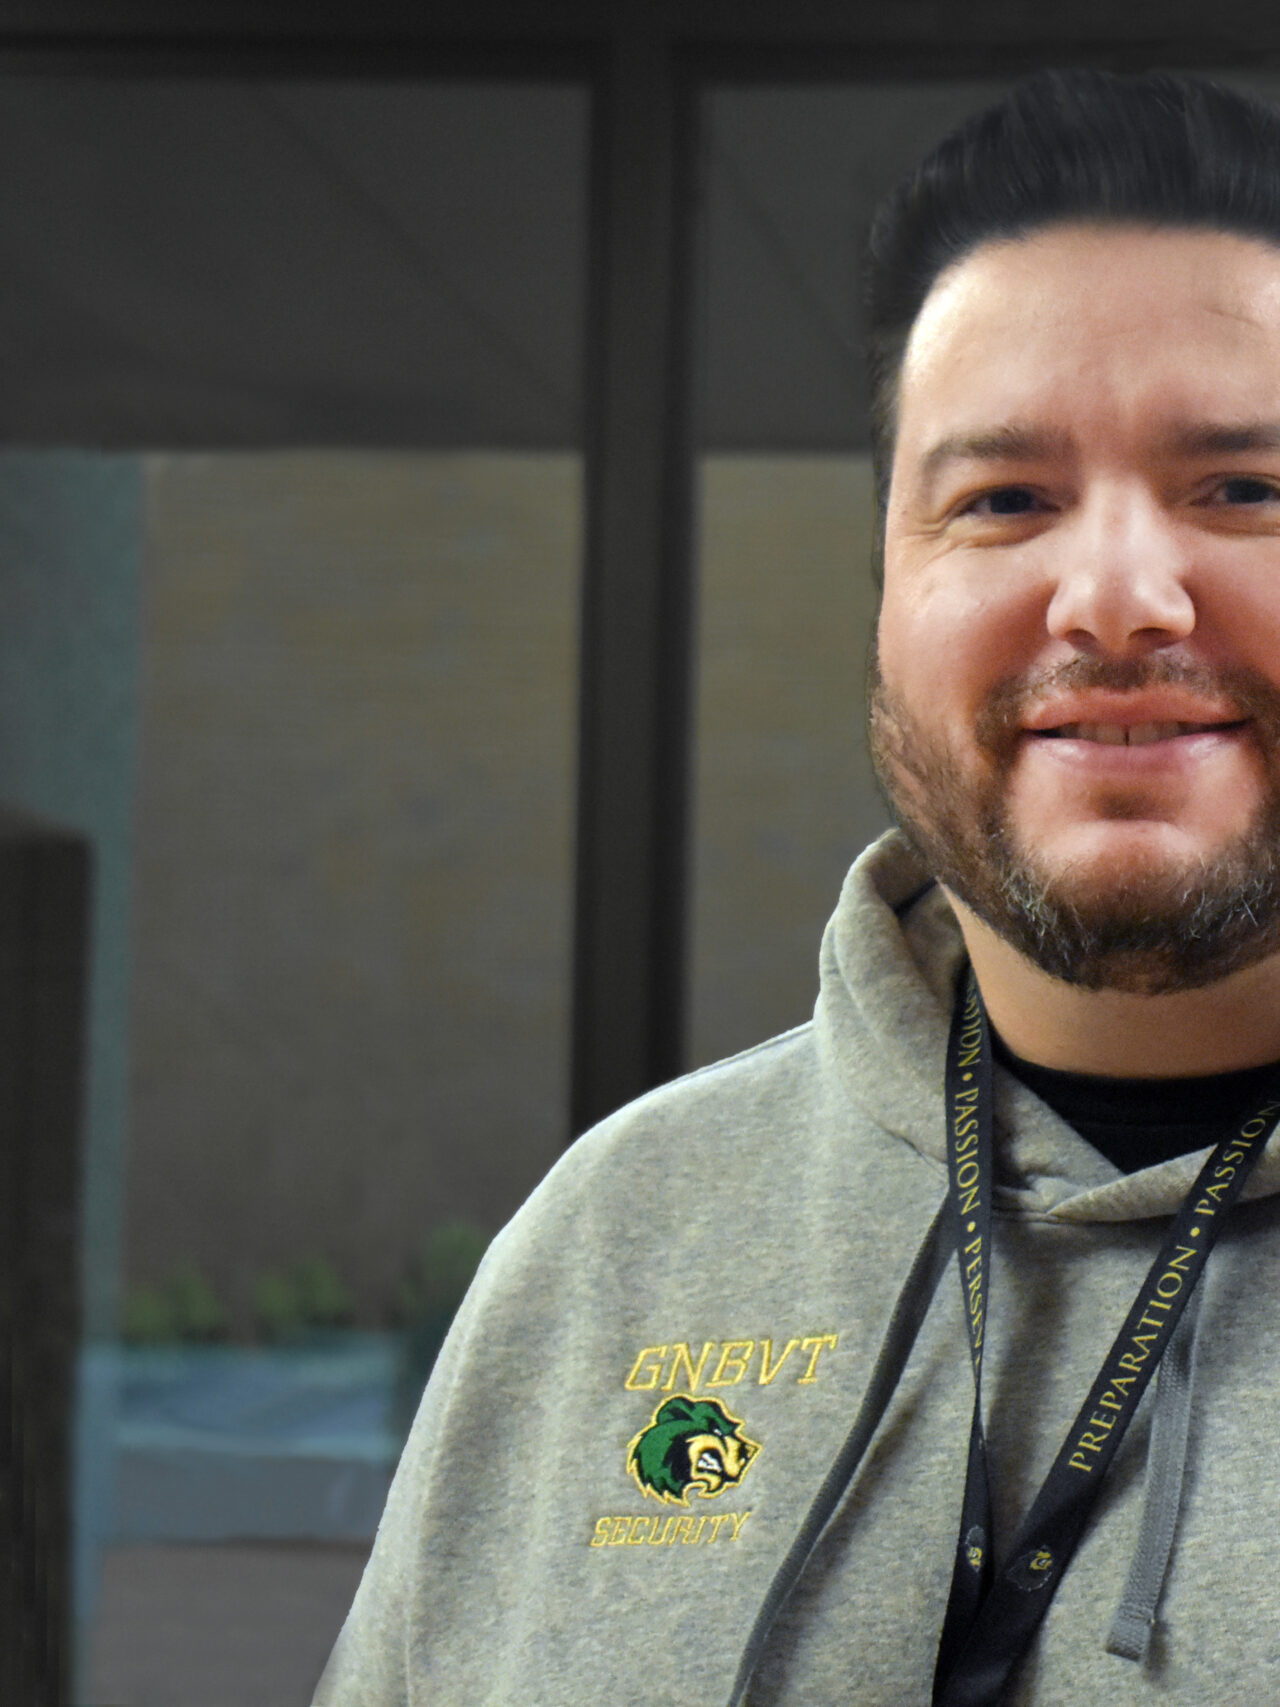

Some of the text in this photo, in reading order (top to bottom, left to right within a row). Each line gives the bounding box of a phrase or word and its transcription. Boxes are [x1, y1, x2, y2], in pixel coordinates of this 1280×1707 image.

[955, 1087, 981, 1216] PASSION
[624, 1333, 838, 1391] GNBVT
[1068, 1245, 1198, 1472] PREPARATION
[590, 1511, 752, 1547] SECURITY
